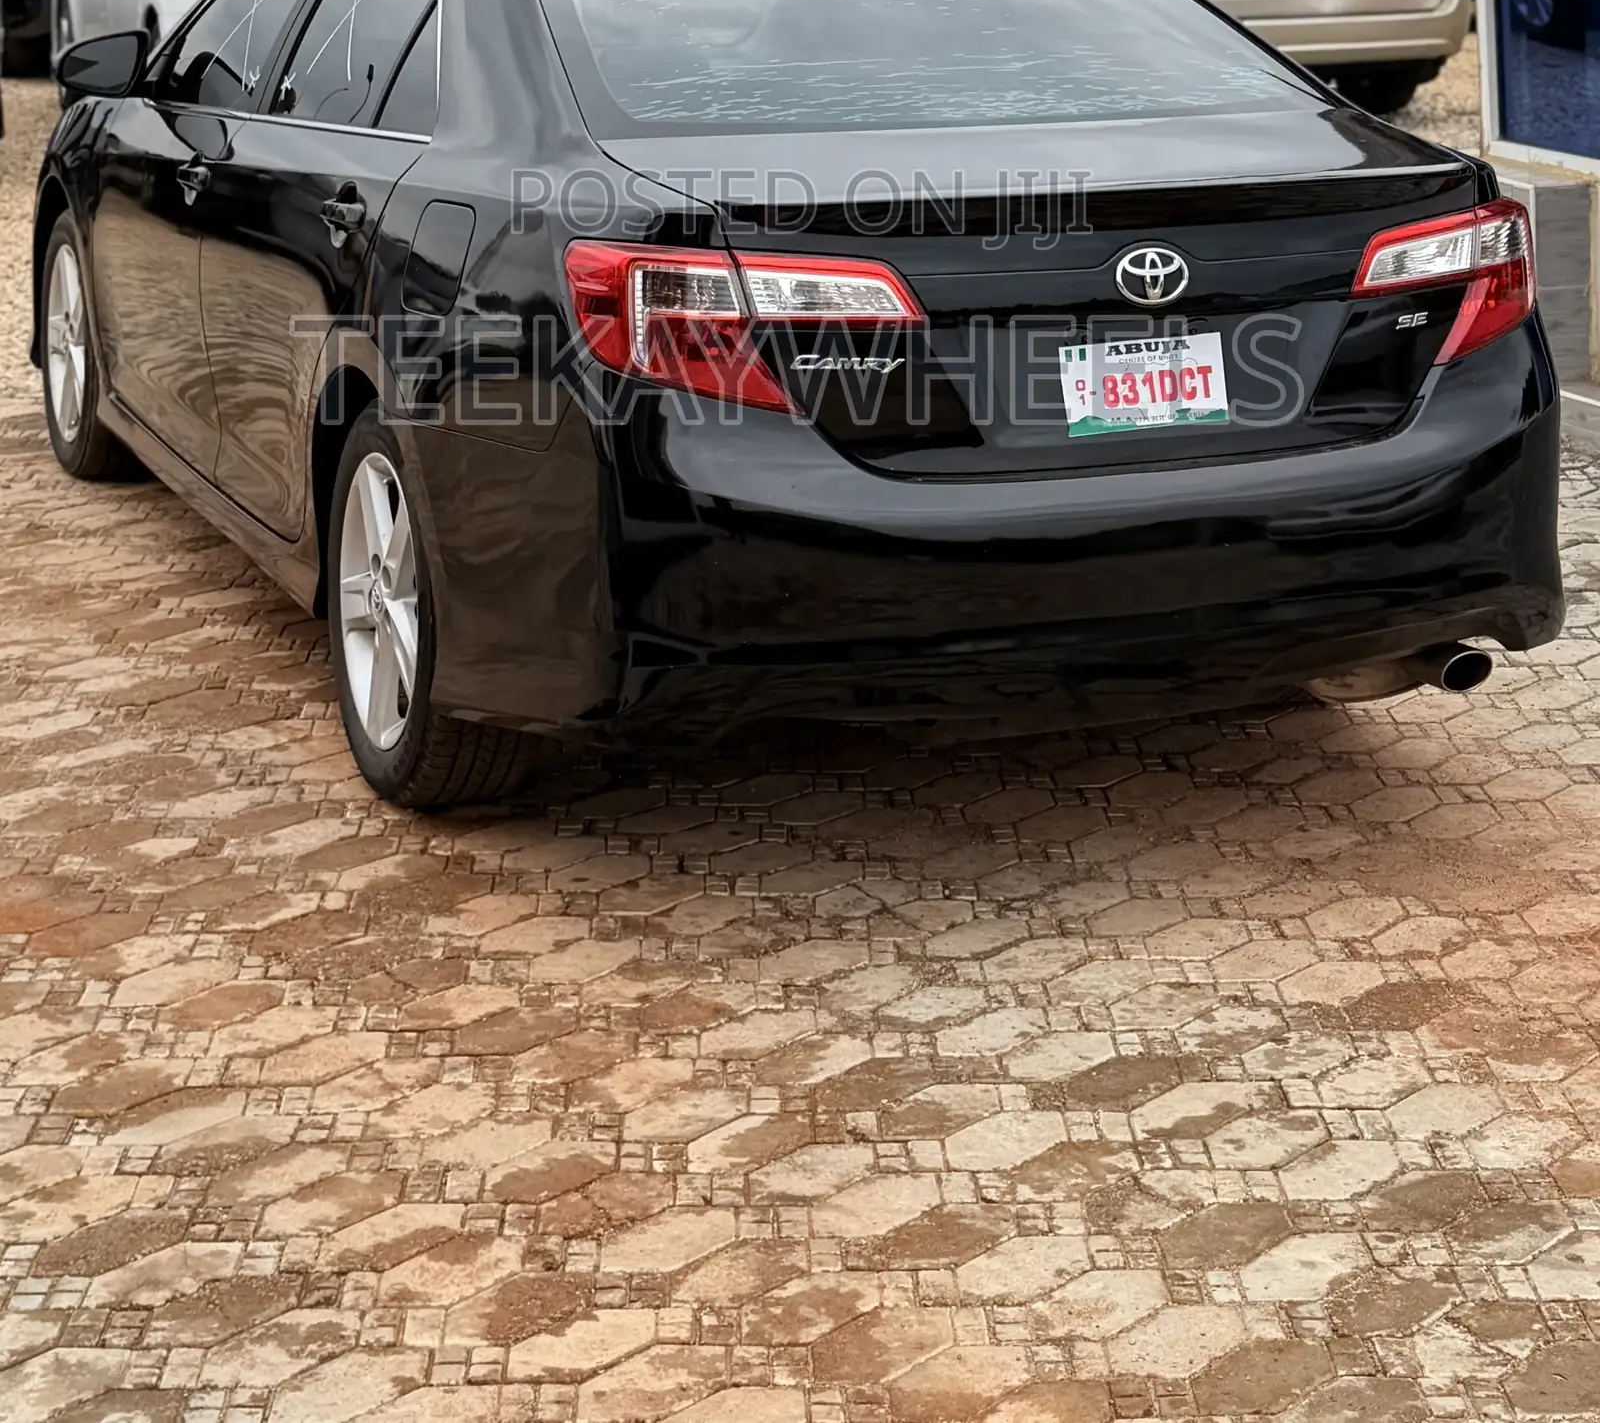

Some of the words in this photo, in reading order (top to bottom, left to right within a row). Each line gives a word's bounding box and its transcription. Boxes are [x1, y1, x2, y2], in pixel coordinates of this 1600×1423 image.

[1395, 311, 1429, 330] SE
[1105, 339, 1191, 357] ABUJA
[789, 354, 906, 374] CAMRY
[1118, 356, 1145, 365] CENTRE
